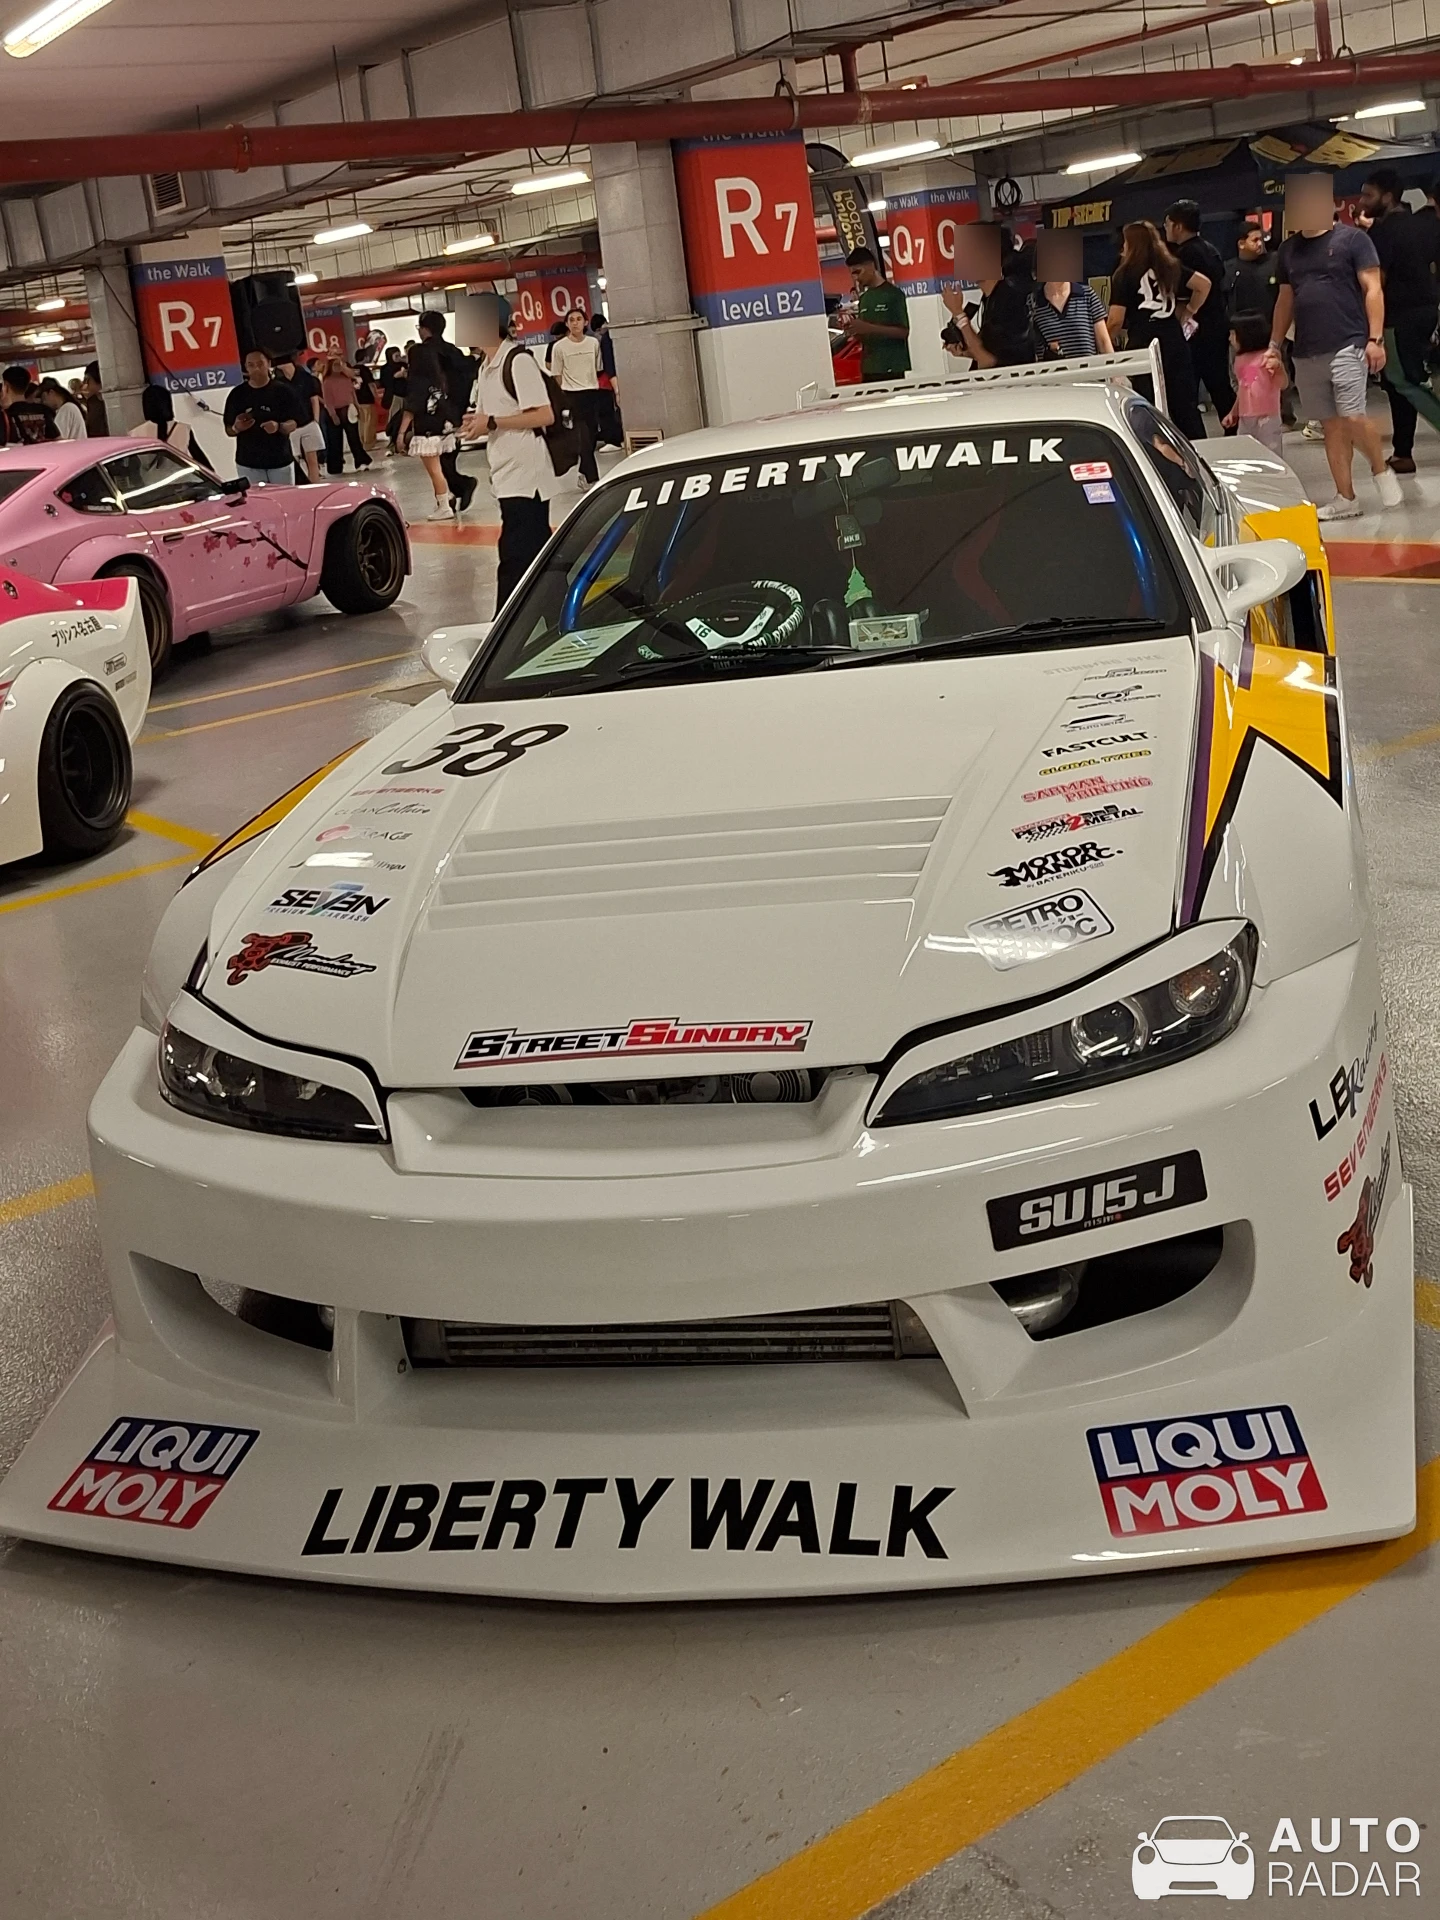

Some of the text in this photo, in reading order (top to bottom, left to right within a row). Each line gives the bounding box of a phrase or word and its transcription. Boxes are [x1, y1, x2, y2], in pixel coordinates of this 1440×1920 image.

[900, 195, 919, 209] Walk
[930, 189, 970, 204] the Walk
[147, 263, 212, 281] the Walk
[916, 282, 928, 294] B2
[722, 290, 804, 321] level B2
[164, 370, 227, 391] level B2
[623, 438, 1064, 512] LIBERTY WALK
[381, 723, 569, 777] 38
[1041, 731, 1149, 758] FASTCULT
[1039, 759, 1100, 776] GLOBAL
[1063, 776, 1153, 803] PRINTING
[1013, 841, 1098, 873] MOTOR
[264, 906, 370, 923] PREMIUM CARWASH
[982, 894, 1084, 936] RETRO
[271, 957, 351, 976] EXHAUST PERFORMANCE
[94, 1422, 249, 1475] LIQUI
[1097, 1411, 1296, 1478] LIQUI
[56, 1467, 221, 1524] MOLY
[1111, 1461, 1308, 1533] MOLY
[301, 1477, 957, 1560] LIBERTY WALK
